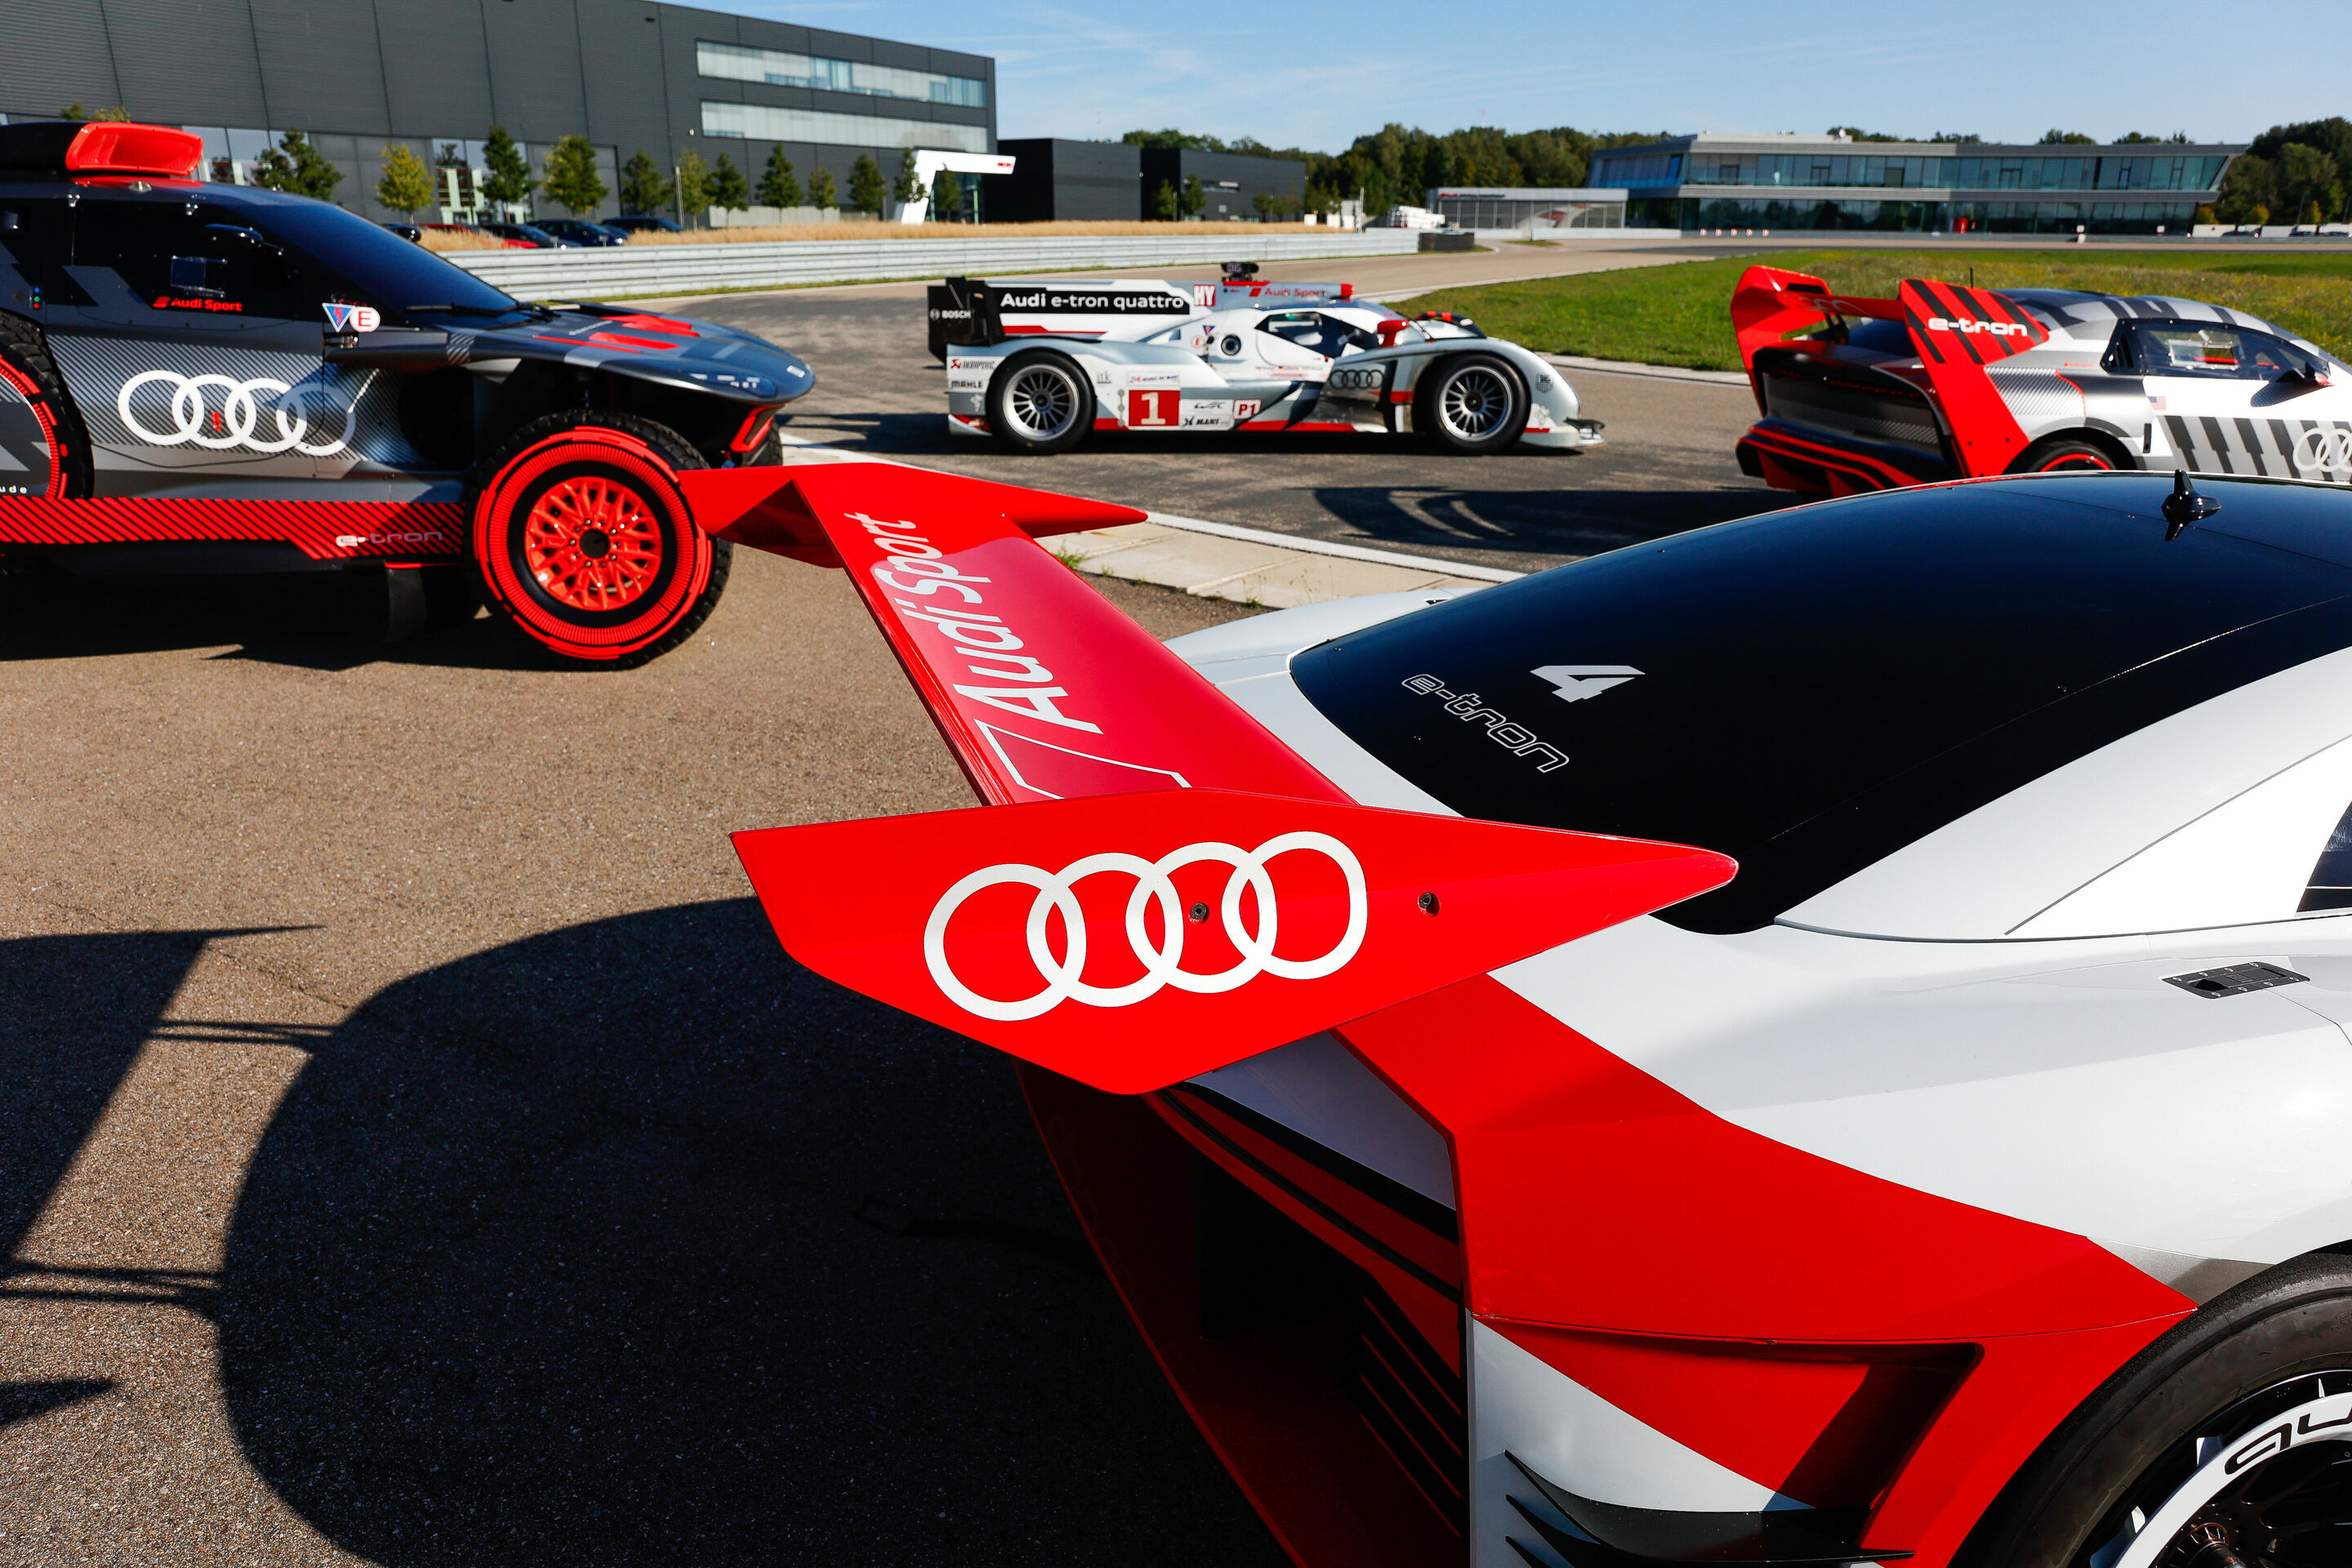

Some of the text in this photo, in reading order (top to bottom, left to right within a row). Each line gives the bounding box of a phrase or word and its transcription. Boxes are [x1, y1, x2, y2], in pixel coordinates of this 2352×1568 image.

[1000, 292, 1184, 310] Audi e-tron quattro
[1194, 285, 1215, 305] HY
[1265, 287, 1327, 298] Audi Sport
[171, 297, 243, 312] Audi Sport
[358, 311, 372, 327] E
[942, 310, 971, 319] BOSCH
[1928, 318, 2028, 336] e-tron
[1141, 391, 1166, 425] 1
[1238, 403, 1257, 416] P1
[336, 532, 443, 547] e-tron
[844, 512, 1104, 735] Audi Sport
[1529, 665, 1646, 703] 4
[1401, 674, 1570, 773] e-tron
